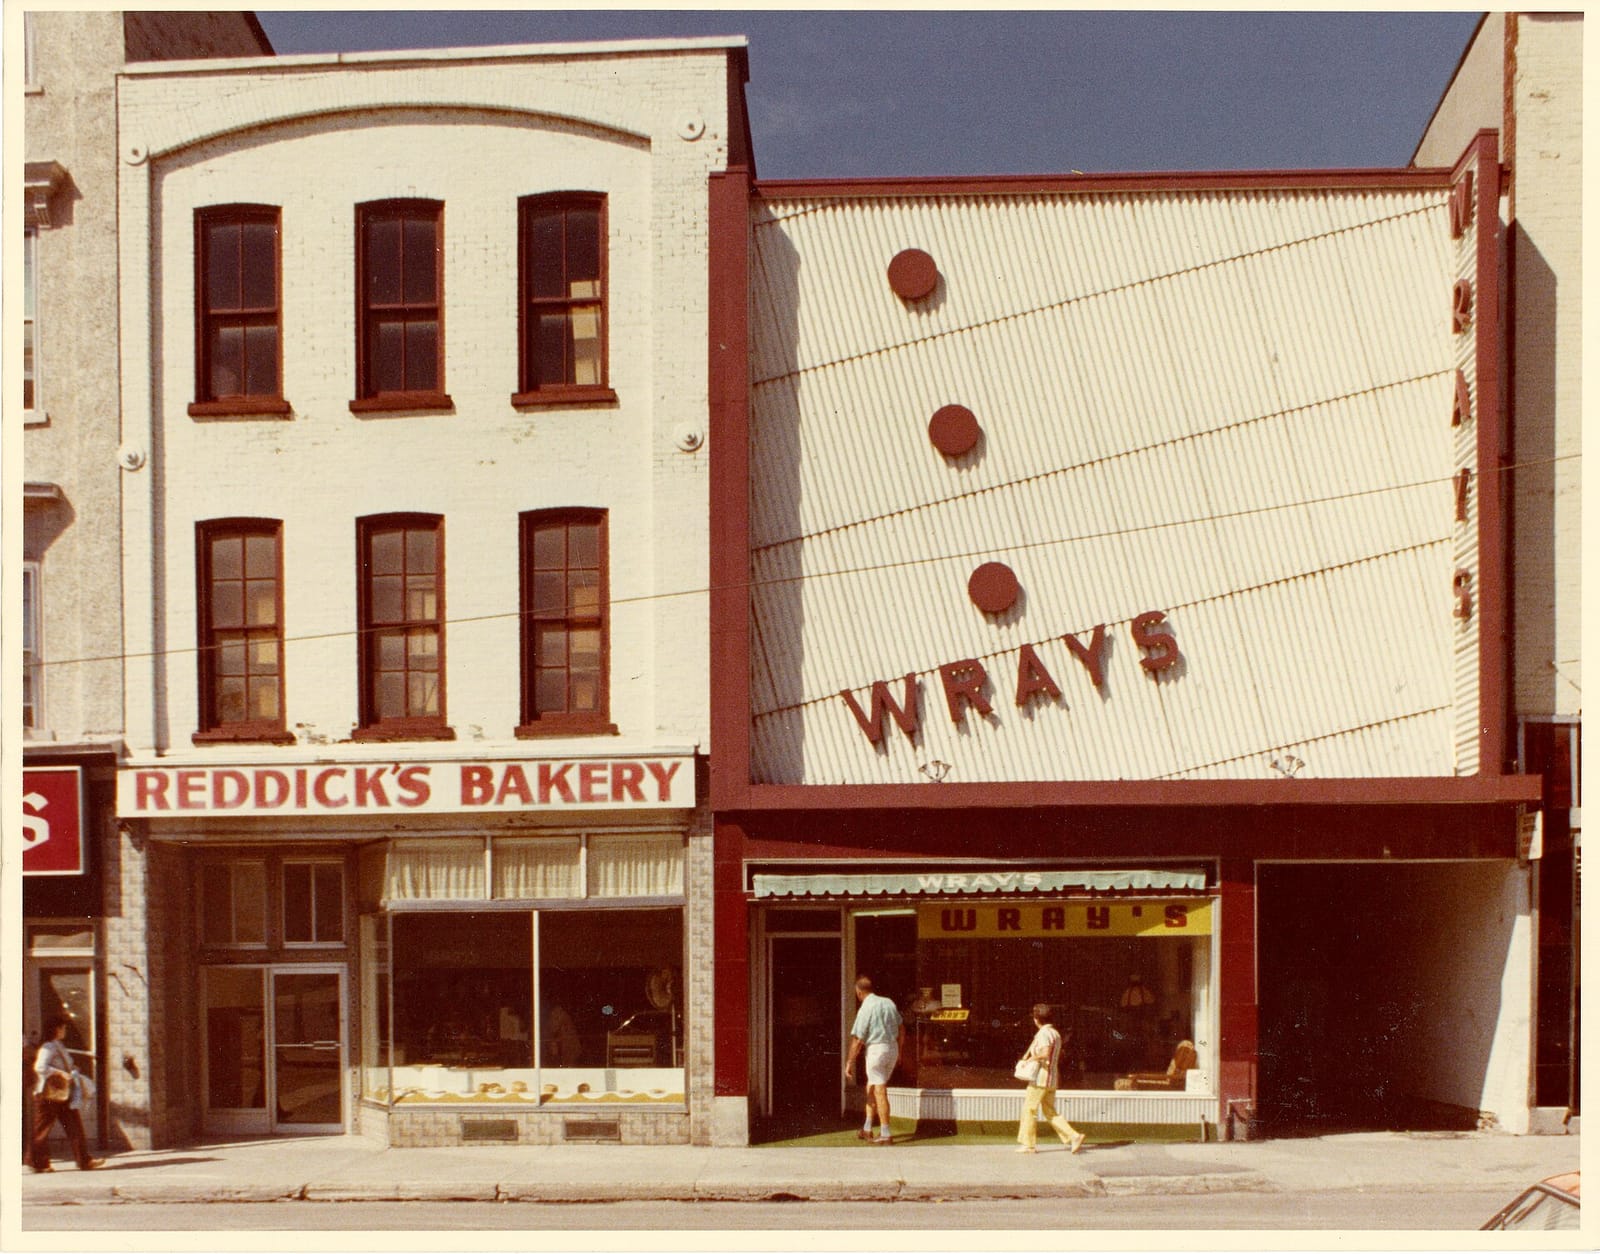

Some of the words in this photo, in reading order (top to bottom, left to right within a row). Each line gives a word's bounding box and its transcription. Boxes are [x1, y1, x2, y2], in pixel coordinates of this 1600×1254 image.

[1450, 170, 1474, 619] WRAYS
[840, 610, 1179, 742] WRAYS
[135, 762, 432, 810] REDDICK'S
[460, 761, 682, 806] BAKERY
[917, 871, 1043, 889] WRAY'S
[940, 904, 1188, 932] WRAY'S
